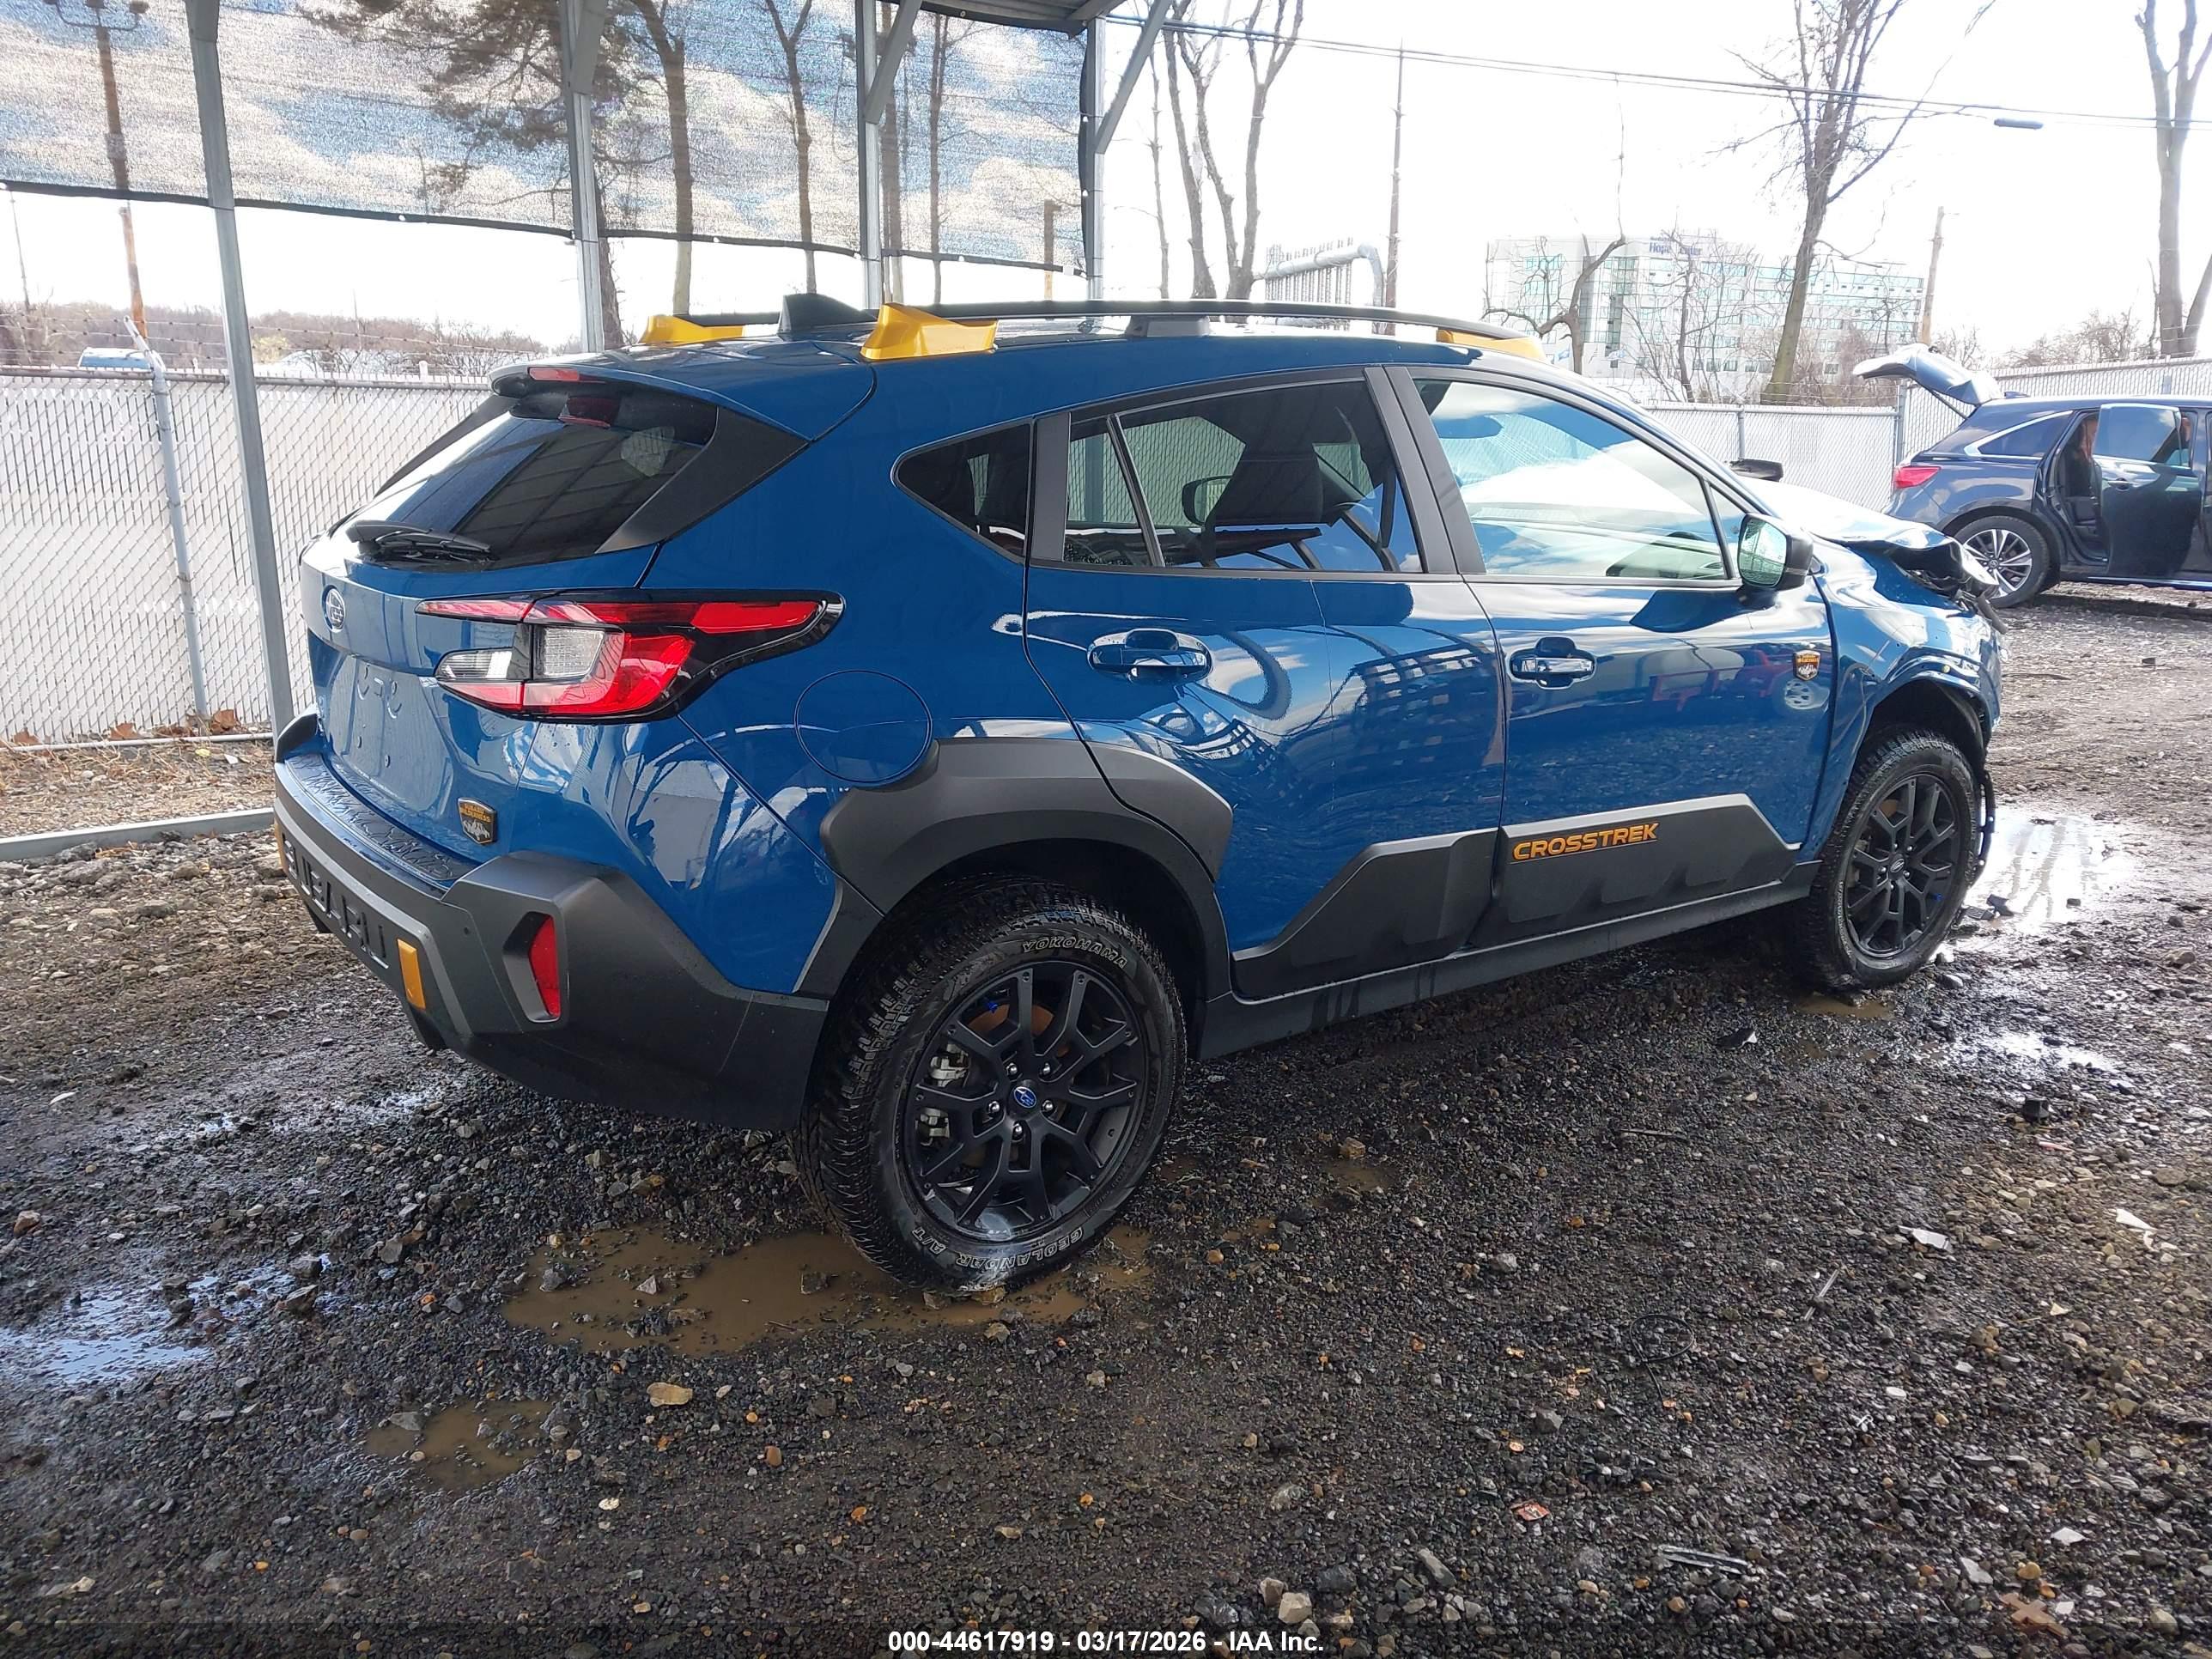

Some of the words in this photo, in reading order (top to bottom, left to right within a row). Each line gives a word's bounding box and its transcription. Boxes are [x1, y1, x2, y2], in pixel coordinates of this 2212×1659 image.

[1514, 823, 1659, 860] CROSSTREK
[282, 833, 389, 969] SUBARU
[1023, 936, 1127, 969] YOKOHAMA
[912, 1226, 945, 1255] A/T
[956, 1227, 1084, 1270] GEOLANDAR
